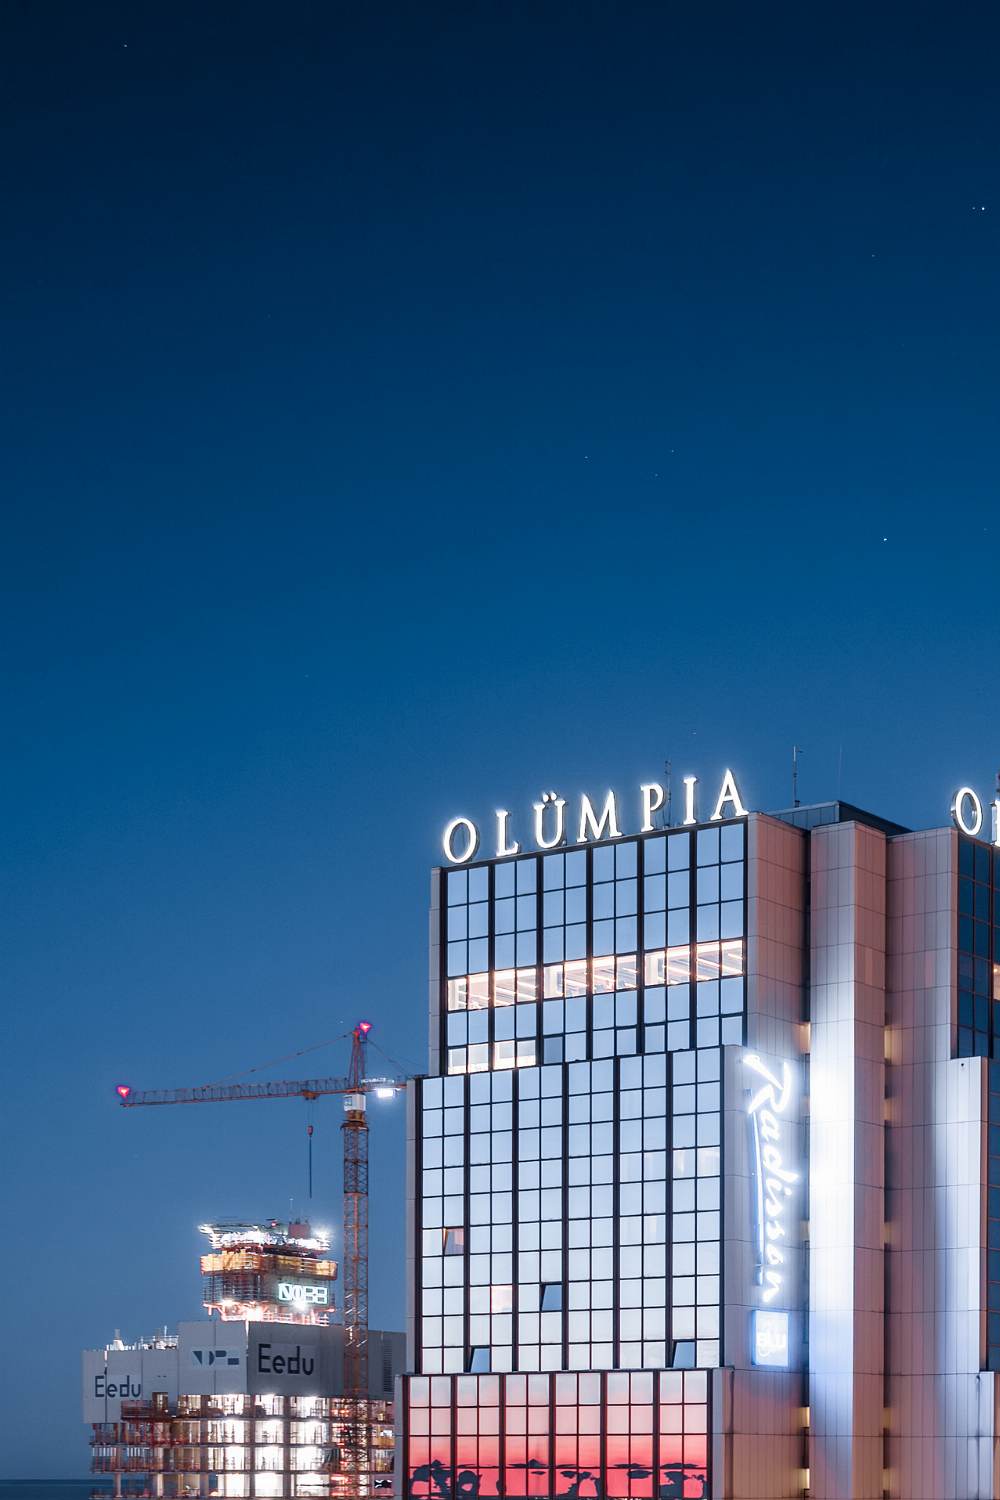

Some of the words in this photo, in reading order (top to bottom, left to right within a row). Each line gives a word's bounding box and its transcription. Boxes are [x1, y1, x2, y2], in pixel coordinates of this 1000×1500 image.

[442, 768, 749, 864] OLÜMPIA
[743, 1054, 799, 1302] Radisson
[95, 1375, 141, 1398] Eedu
[258, 1343, 314, 1376] Eedu
